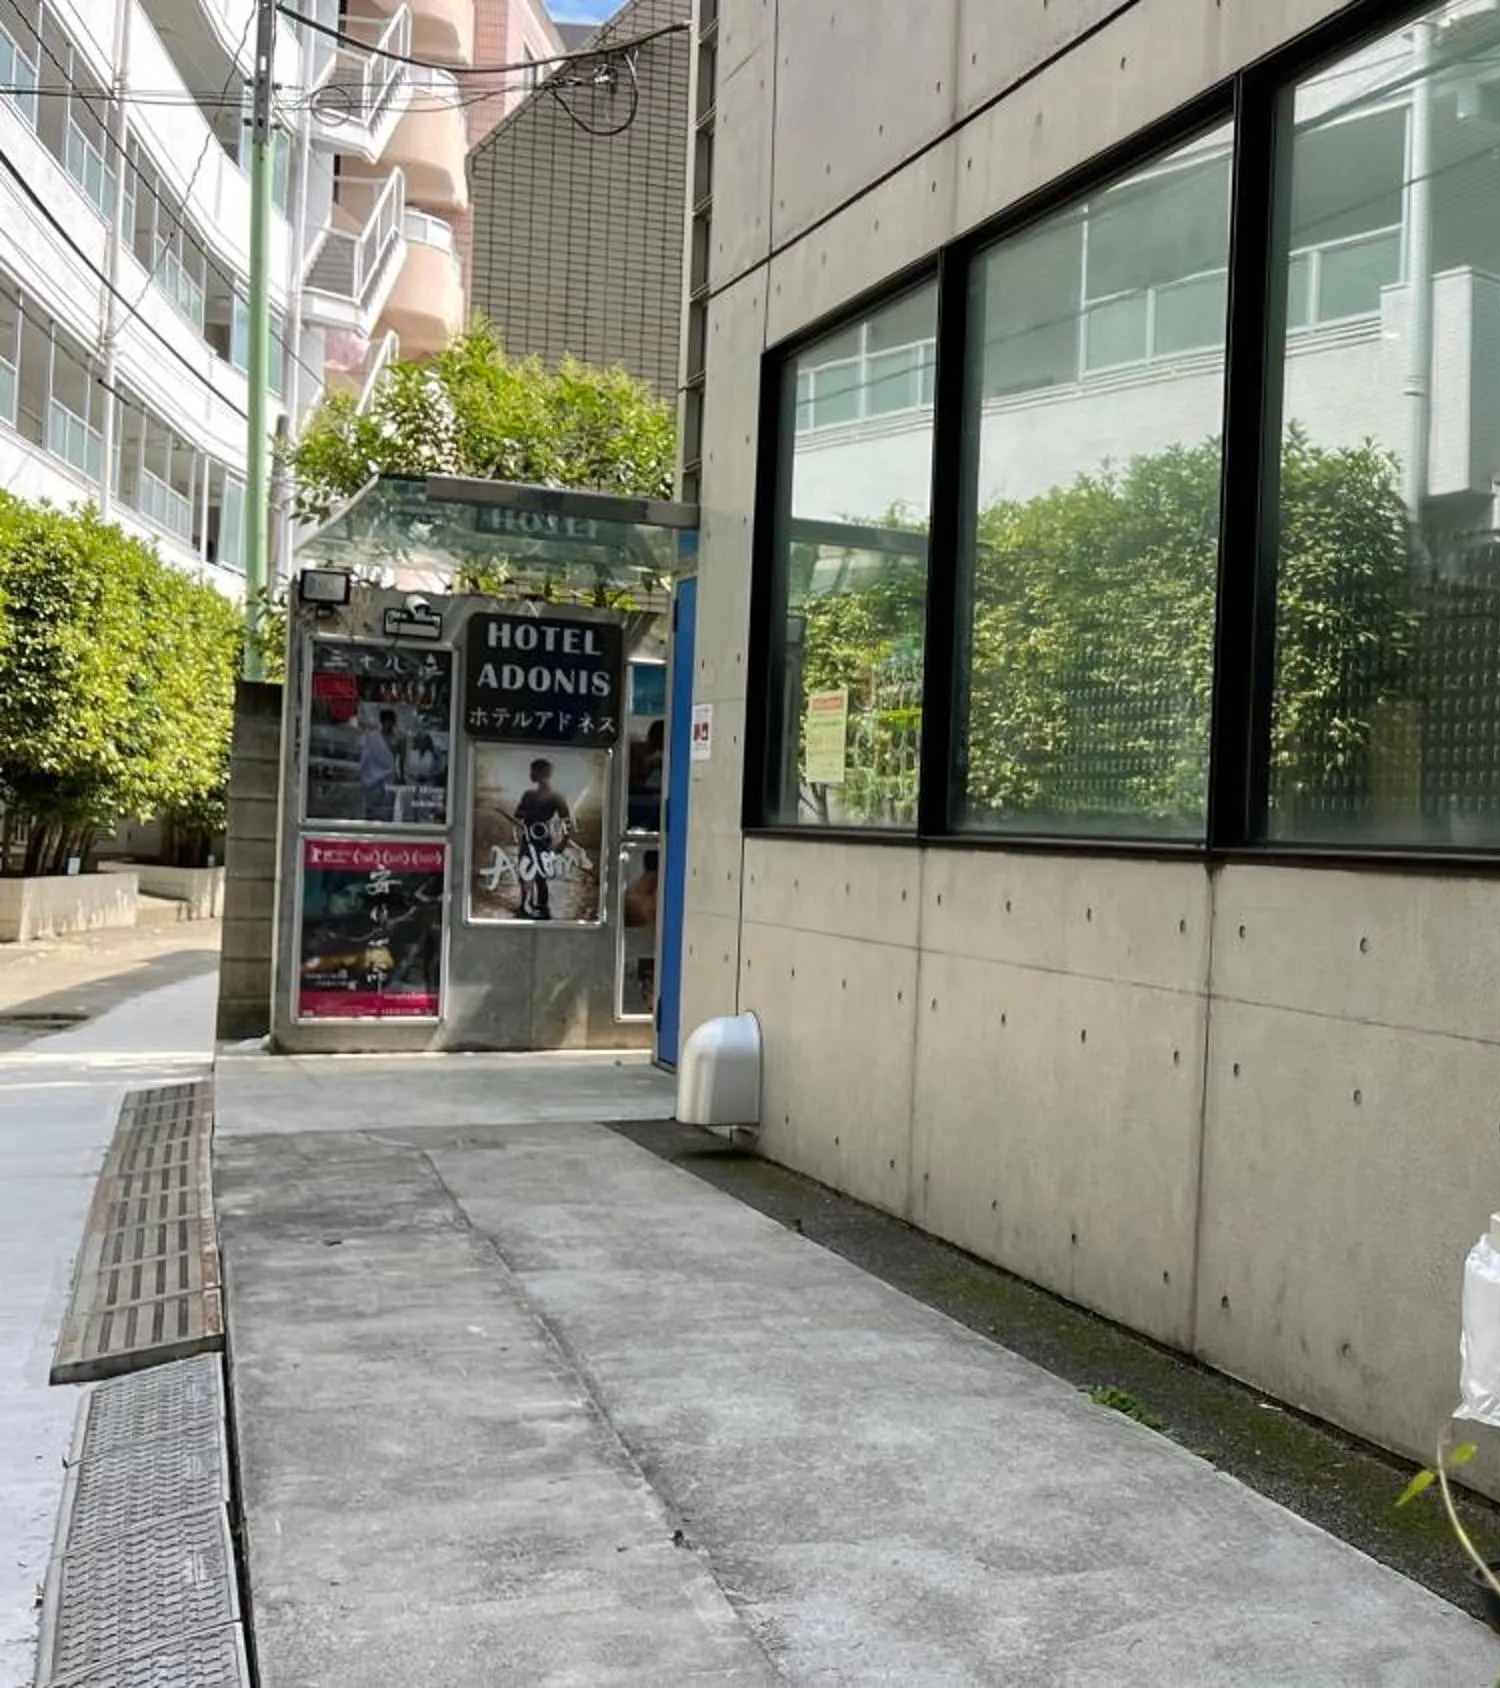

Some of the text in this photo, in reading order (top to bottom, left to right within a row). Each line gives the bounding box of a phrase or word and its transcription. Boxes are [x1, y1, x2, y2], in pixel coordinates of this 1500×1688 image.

[487, 620, 603, 656] HOTEL
[476, 662, 611, 698] ADONIS
[468, 706, 616, 734] ホテルアドネス
